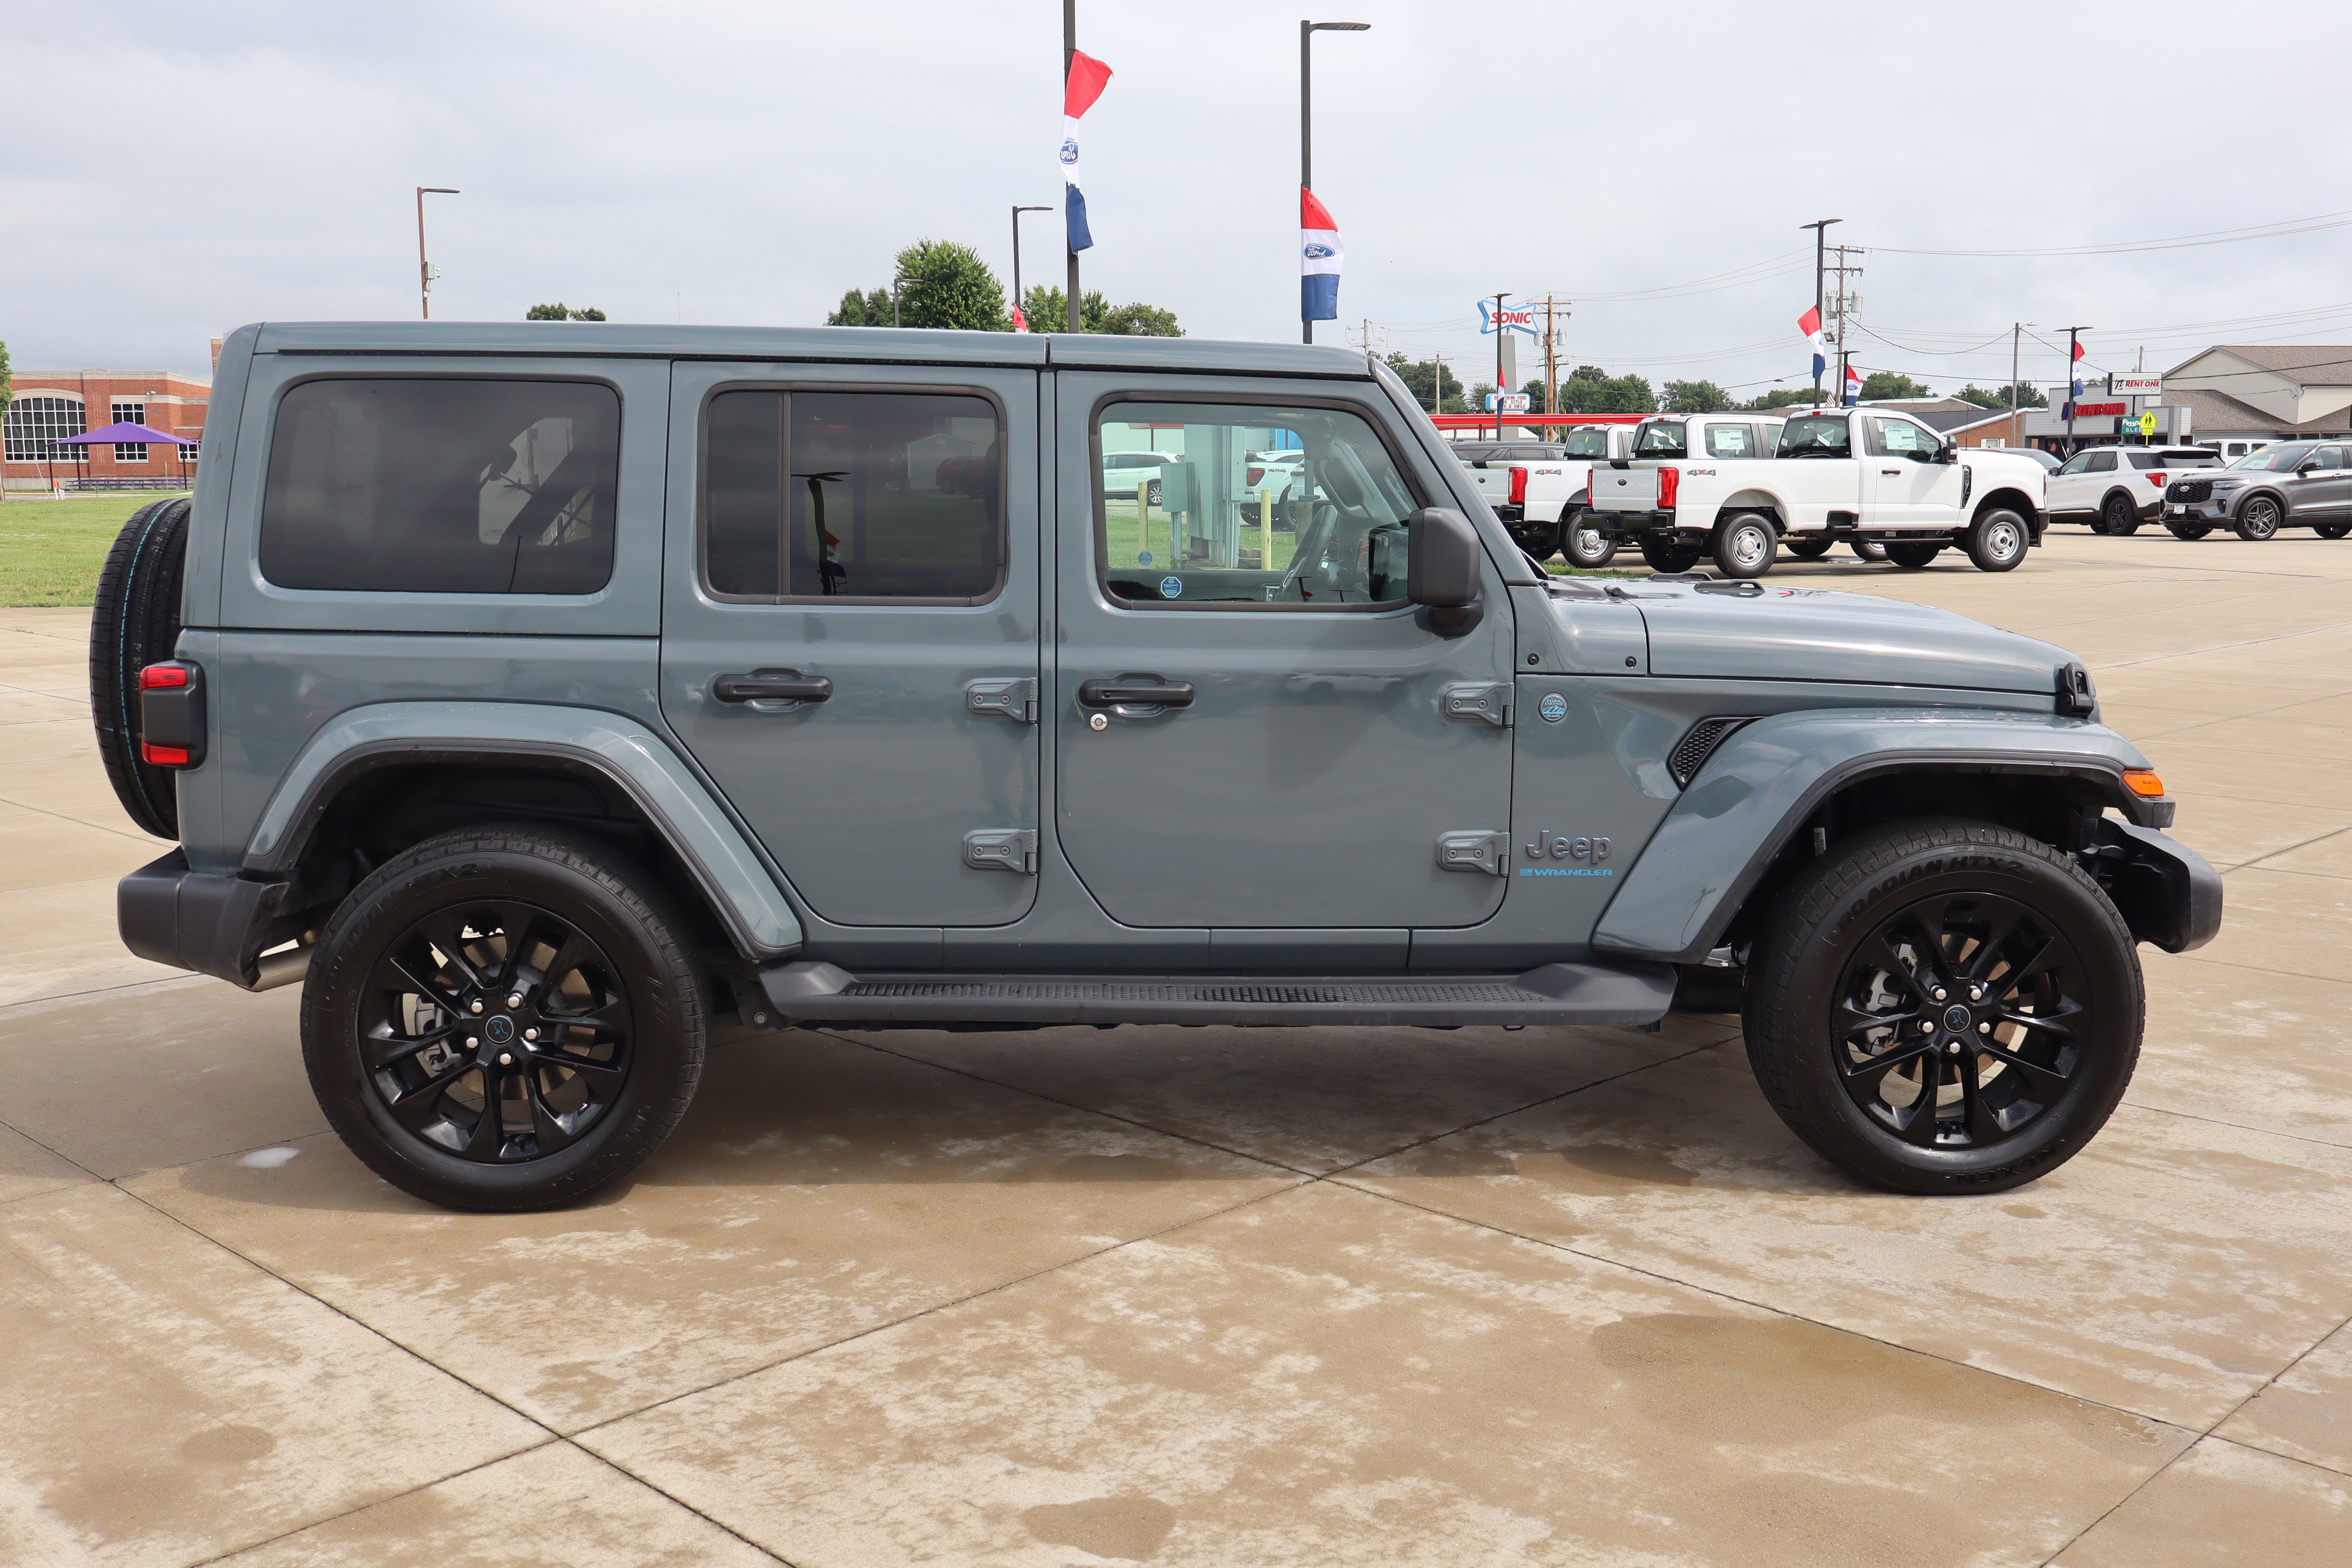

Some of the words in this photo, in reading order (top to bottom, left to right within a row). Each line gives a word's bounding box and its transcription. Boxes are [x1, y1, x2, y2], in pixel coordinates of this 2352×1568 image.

[1307, 245, 1326, 256] Ford
[1490, 312, 1532, 324] SONIC
[2076, 404, 2103, 416] RENT
[2103, 403, 2125, 415] ONE
[1526, 829, 1613, 865] Jeep
[1838, 859, 1943, 930] ROADIAN
